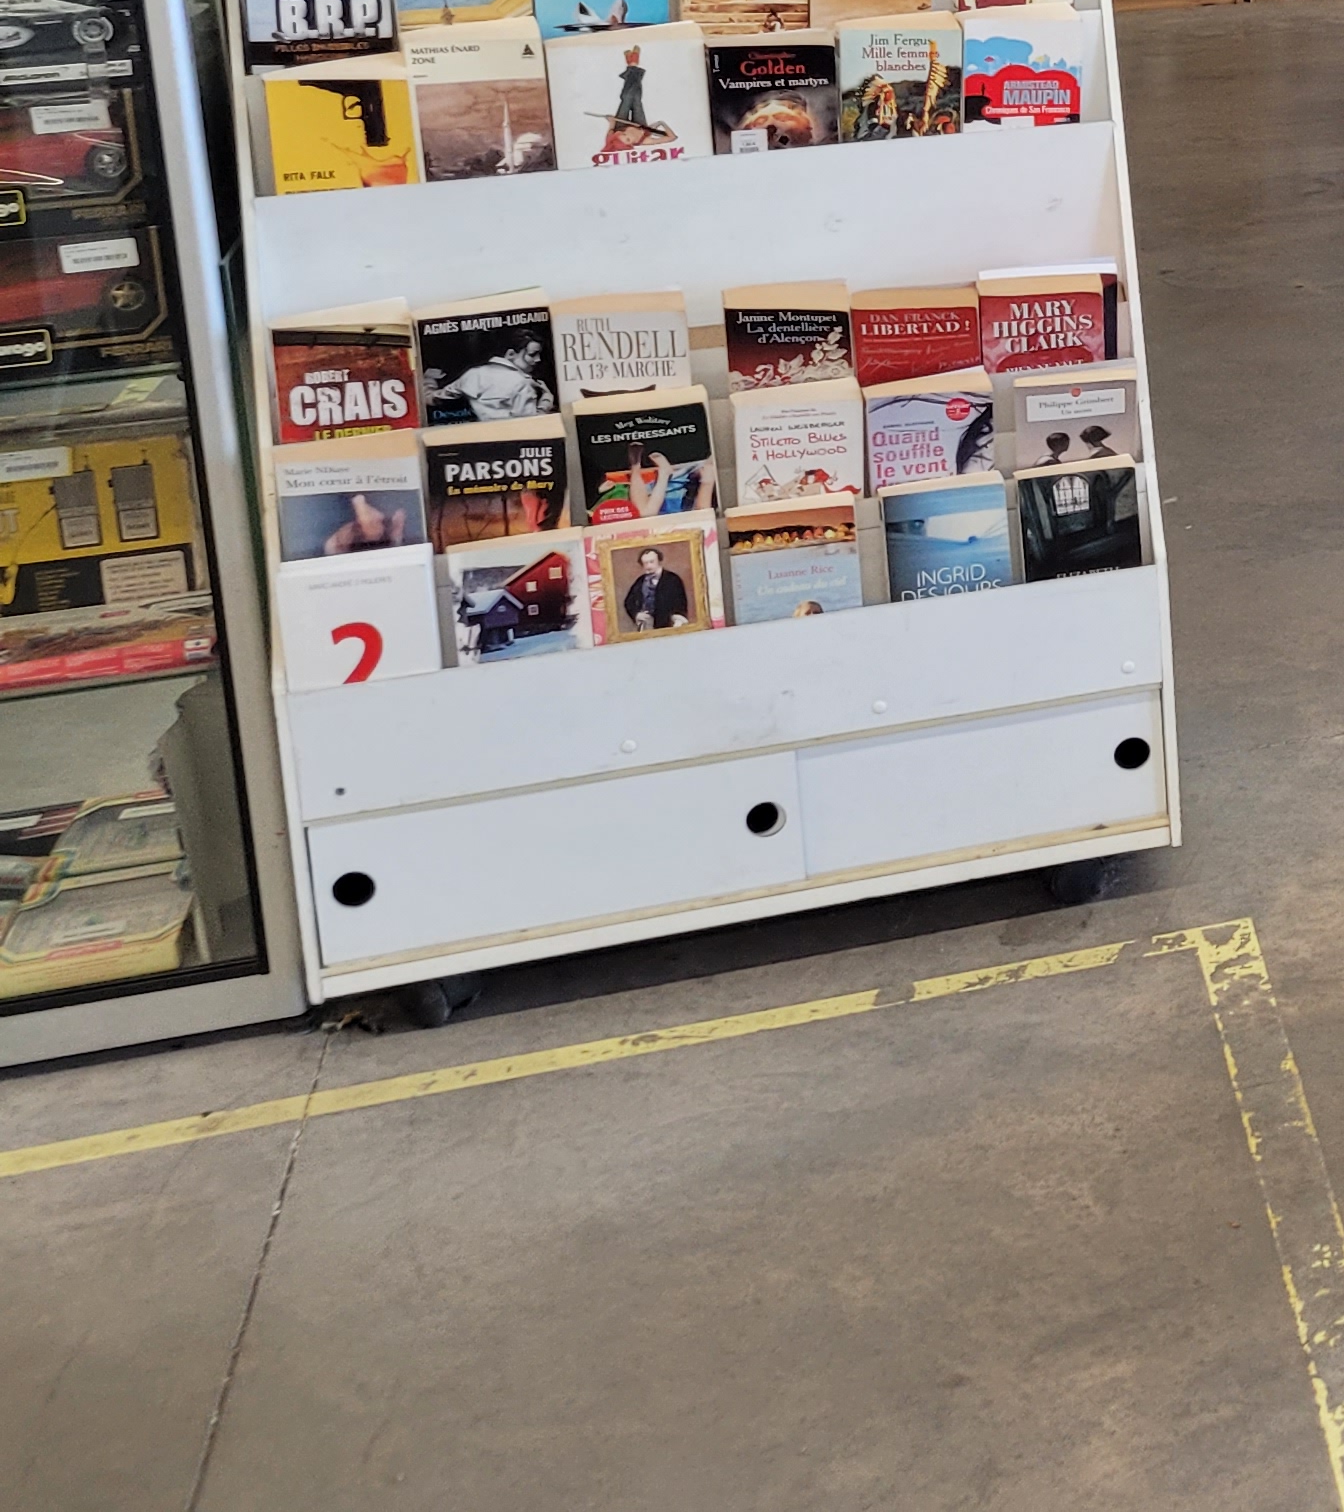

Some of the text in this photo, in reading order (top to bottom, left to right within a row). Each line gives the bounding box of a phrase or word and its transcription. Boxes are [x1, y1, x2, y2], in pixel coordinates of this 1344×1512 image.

[869, 33, 934, 47] Jim Fergus
[410, 44, 480, 55] MATHIAS ÉNARD
[862, 46, 894, 60] Mille
[411, 56, 436, 65] ZONE
[740, 60, 806, 76] Golden
[876, 59, 927, 72] blanches
[719, 76, 829, 91] Vampires martyrs
[1003, 89, 1070, 105] MAUPIN
[283, 170, 336, 182] RITA FALK
[736, 311, 837, 324] Janine Montupet
[903, 312, 961, 323] FRANCK
[1010, 299, 1076, 320] MARY
[423, 311, 549, 336] AGNÈS MARTIN-LUGAND
[576, 317, 611, 332] RUTH
[746, 322, 830, 334] La dentellière
[861, 321, 961, 337] LIBERTAD
[992, 314, 1093, 339] HIGGINS
[560, 329, 687, 363] RENDELL
[757, 332, 821, 345] d'Alençon
[1005, 331, 1084, 354] CLARK
[304, 369, 351, 385] ROBERT
[564, 360, 677, 382] LA MARCHE
[289, 378, 409, 427] CRAIS
[591, 424, 697, 444] LES INTÉRESSANTS
[872, 427, 941, 447] Quand
[519, 447, 553, 459] JULIE
[873, 444, 945, 464] souffle
[445, 458, 553, 482] PARSONS
[877, 458, 948, 479] le vent
[286, 478, 314, 489] Mon
[810, 564, 834, 575] Rice
[916, 563, 986, 586] INGRID
